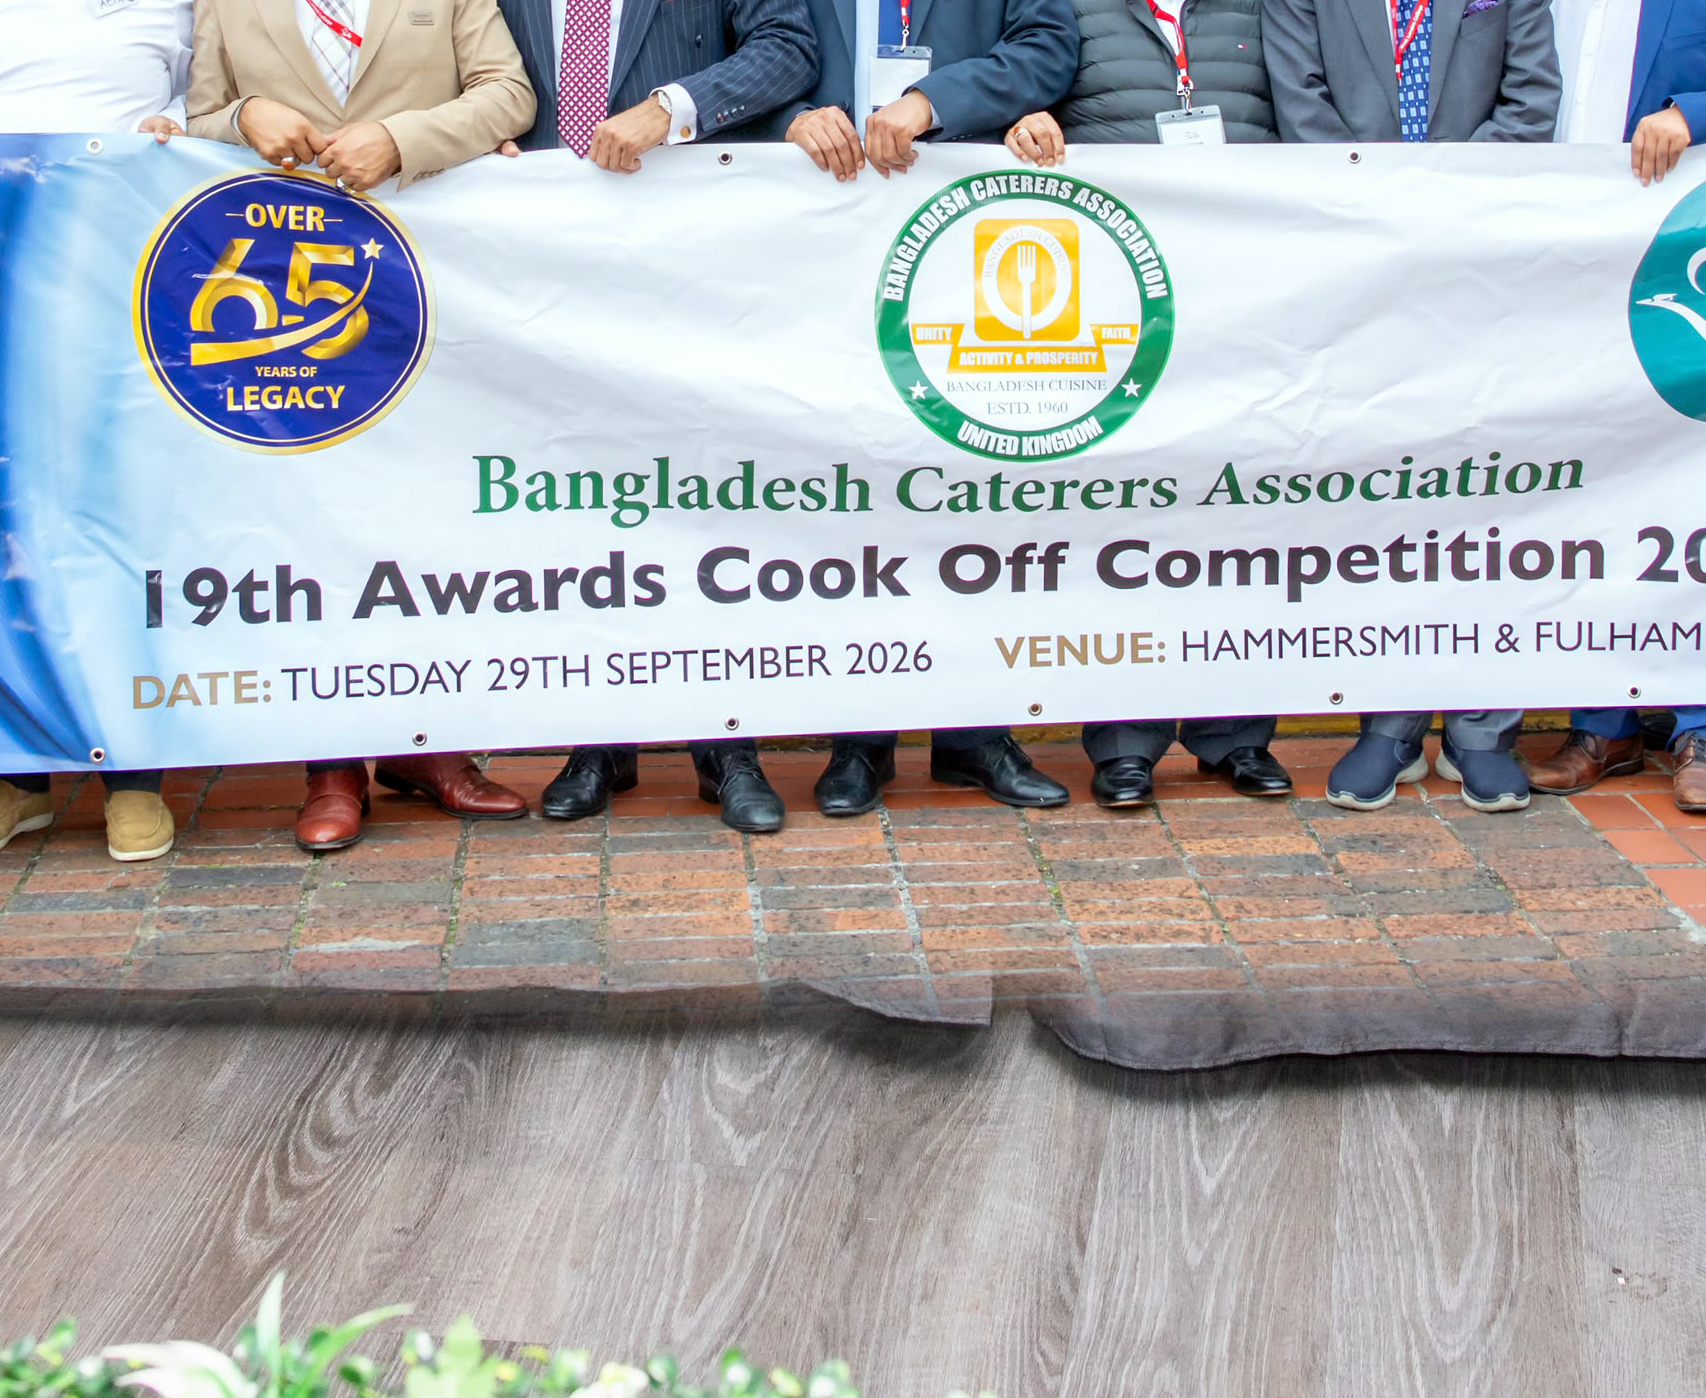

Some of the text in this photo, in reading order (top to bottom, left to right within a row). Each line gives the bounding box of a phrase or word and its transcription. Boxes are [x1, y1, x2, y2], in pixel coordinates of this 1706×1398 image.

[245, 203, 325, 232] OVER
[883, 174, 1169, 302] BANGLADESH CATERERS ASSOCIATION
[190, 237, 370, 364] 65
[915, 326, 953, 341] UNITY
[1101, 327, 1132, 340] FAITH
[255, 366, 318, 378] YEARS OF
[958, 352, 1013, 366] ACTIVITY
[1026, 351, 1099, 365] PROSPERITY
[226, 385, 346, 412] LEGACY
[946, 379, 1108, 393] BANGLADESH CUISINE
[986, 402, 1069, 415] ESTD. 1960
[956, 415, 1104, 457] UNITED KINGDOM
[472, 451, 1585, 529] Bangladesh Caterers Association
[145, 564, 323, 629] 19th
[351, 550, 668, 620] Awards
[696, 545, 912, 604] Cook
[937, 540, 1070, 595] Off
[1095, 527, 1605, 603] Competition
[132, 669, 273, 710] DATE:
[281, 659, 473, 701] TUESDAY
[487, 653, 591, 692] 29TH
[606, 644, 833, 687] SEPTEMBER
[845, 639, 934, 677] 2026
[994, 631, 1166, 670] VENUE:
[1181, 622, 1480, 663] HAMMERSMITH
[1494, 622, 1522, 654] &
[1535, 620, 1703, 653] FULHAM
